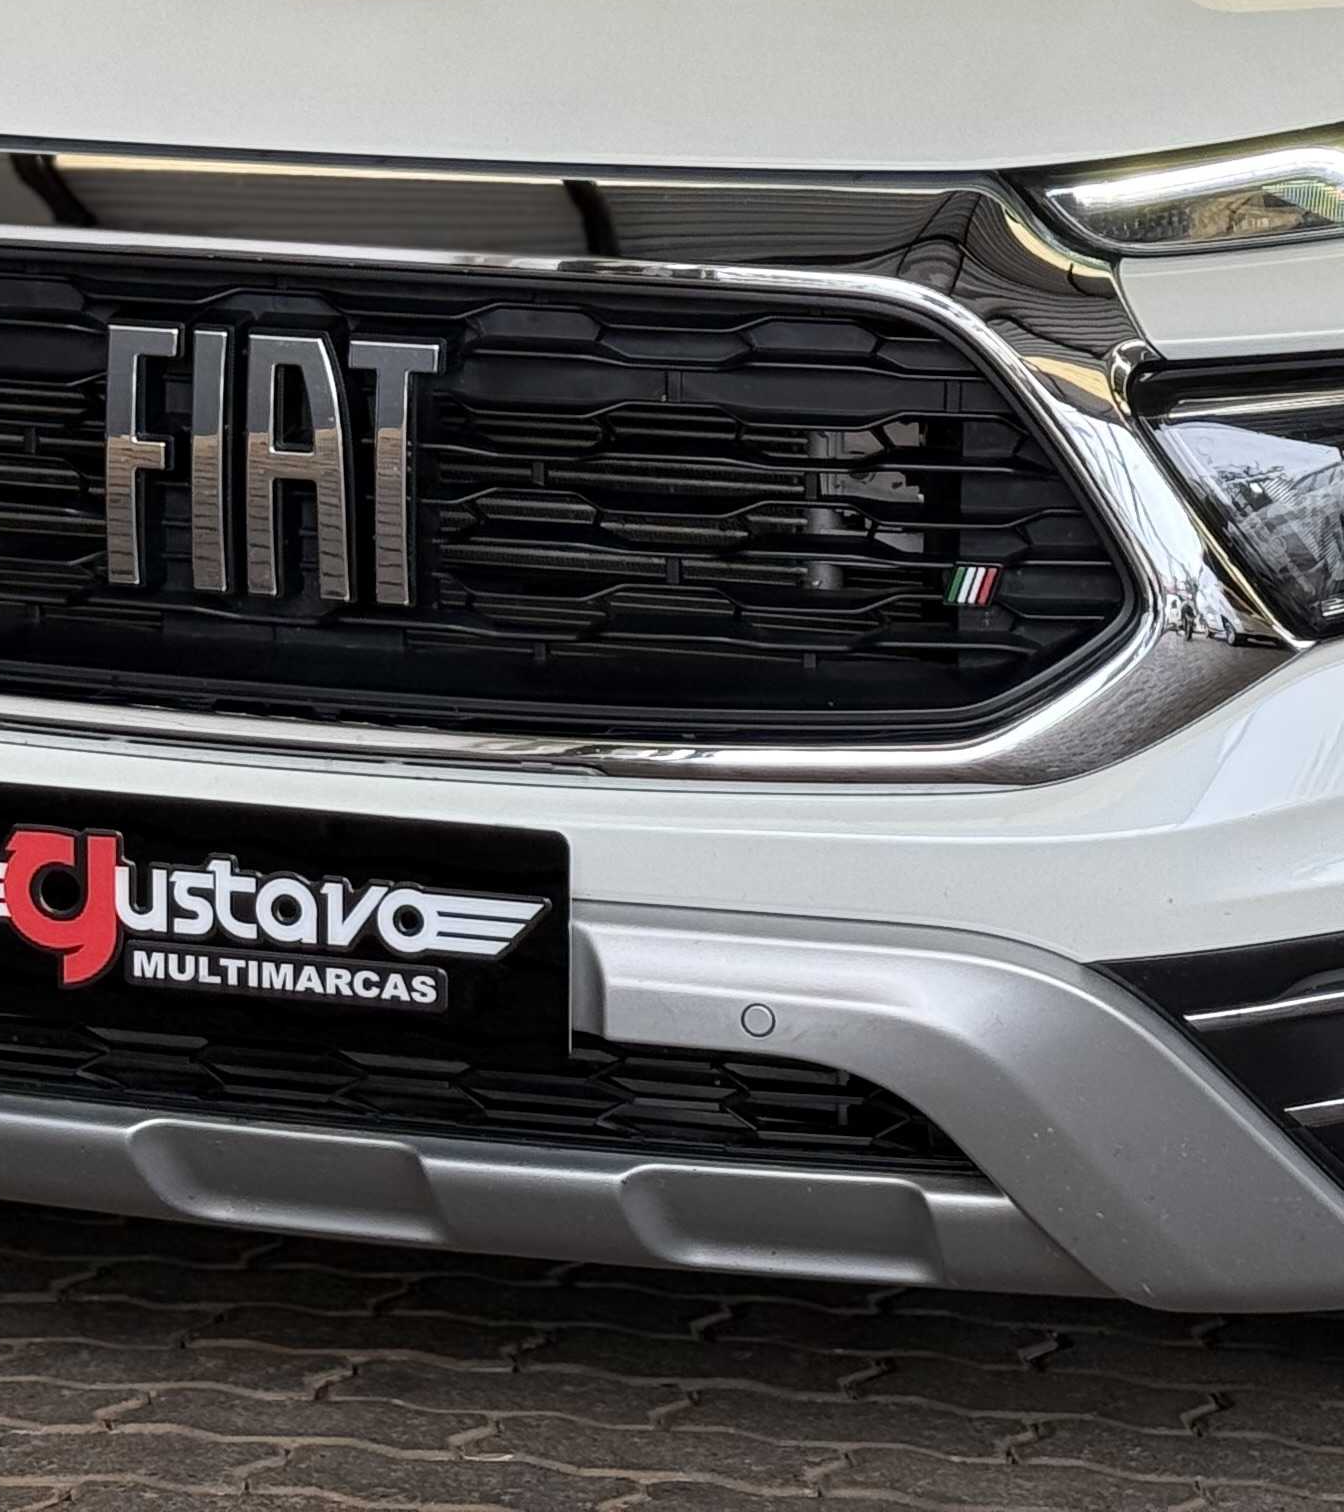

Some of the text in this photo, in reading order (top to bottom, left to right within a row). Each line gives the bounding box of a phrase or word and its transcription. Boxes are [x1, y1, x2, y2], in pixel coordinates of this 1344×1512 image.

[106, 324, 440, 606] FIAT
[3, 830, 436, 984] gustavo
[132, 949, 439, 1005] MULTIMARCAS
